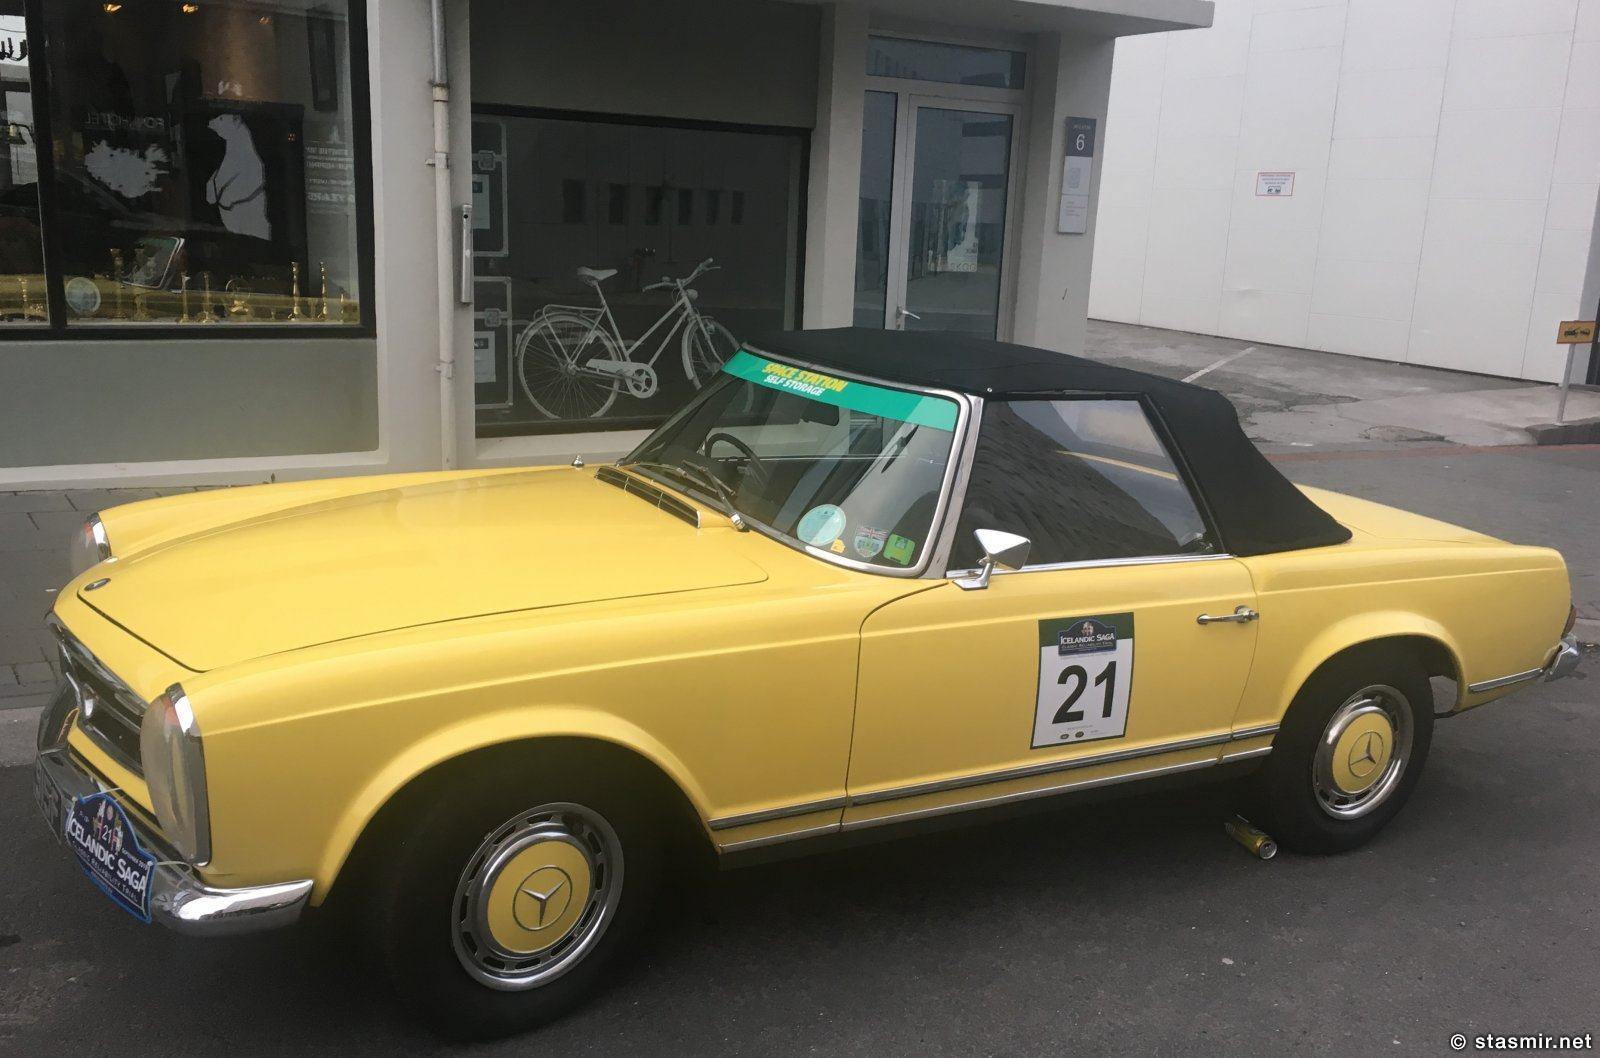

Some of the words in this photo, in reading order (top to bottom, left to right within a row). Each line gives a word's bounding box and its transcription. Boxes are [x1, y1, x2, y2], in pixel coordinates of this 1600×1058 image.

[1076, 133, 1085, 151] 6
[762, 363, 799, 379] SPACE
[796, 370, 848, 392] STATION
[764, 374, 786, 385] SELF
[782, 379, 825, 396] STORAGE
[1060, 635, 1096, 645] ICELANDIC
[1096, 632, 1115, 641] SAGA
[1052, 661, 1117, 724] 21
[102, 824, 112, 844] 21
[67, 811, 115, 870] ICELANDIC
[117, 858, 147, 893] SAGA
